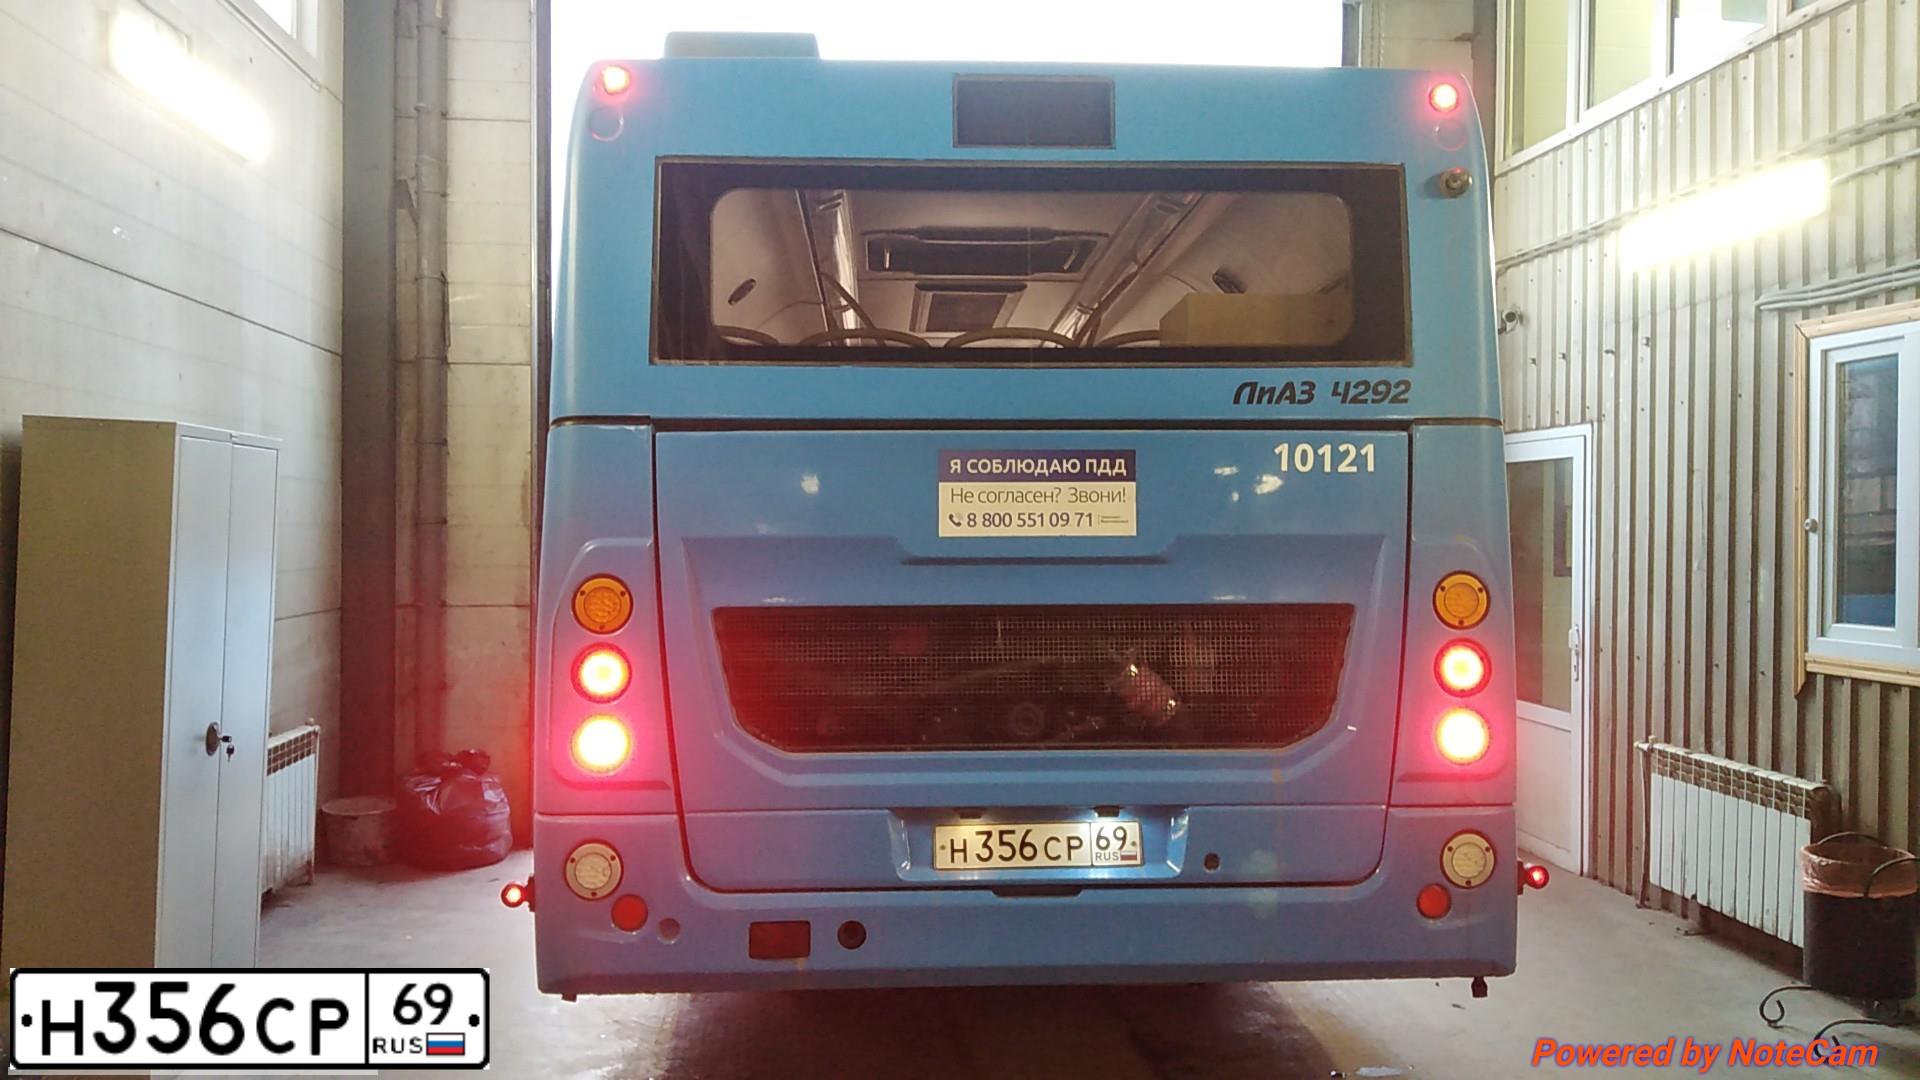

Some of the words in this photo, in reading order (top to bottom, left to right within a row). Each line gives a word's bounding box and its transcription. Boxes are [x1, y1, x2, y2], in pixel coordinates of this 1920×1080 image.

[1331, 379, 1412, 405] 4292
[1274, 443, 1375, 472] 10121
[950, 459, 961, 474] Я
[966, 458, 1081, 477] СОБЛЮДАЮ
[1085, 459, 1127, 477] ПДД
[950, 487, 974, 504] Не
[977, 487, 1062, 504] согласен?
[1068, 487, 1126, 504] Звони!
[966, 513, 977, 527] 8
[982, 512, 1012, 527] 800
[1075, 512, 1093, 527] 71
[1095, 826, 1127, 850] 69
[1095, 852, 1119, 861] RUS
